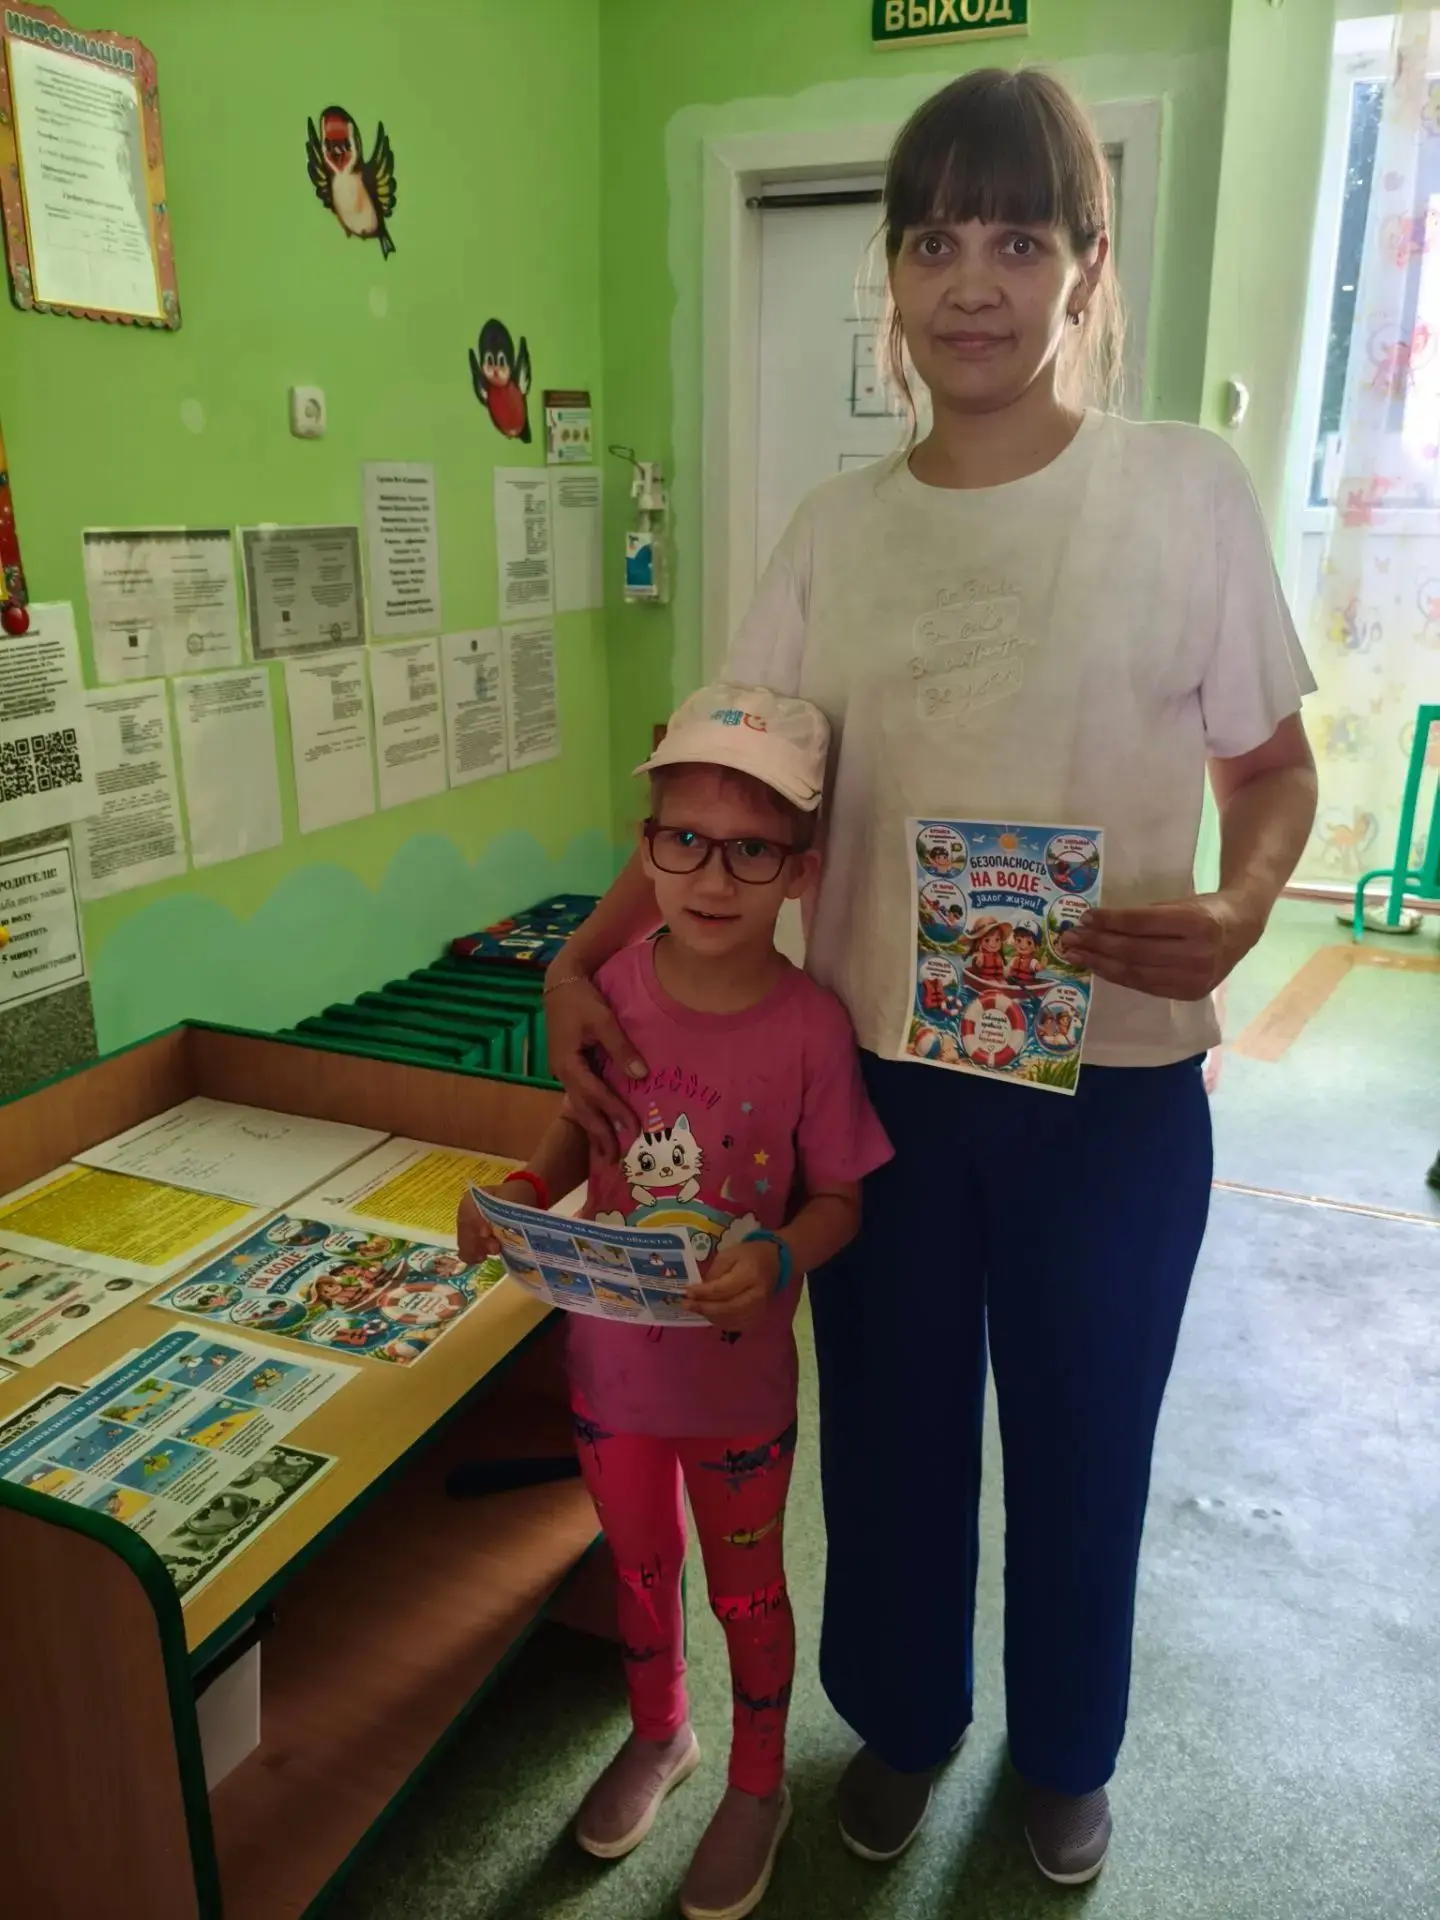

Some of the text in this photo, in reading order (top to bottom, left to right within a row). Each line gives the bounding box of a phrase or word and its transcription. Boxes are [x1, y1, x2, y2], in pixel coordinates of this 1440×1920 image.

[885, 0, 1012, 31] ВЫХОД
[5, 9, 135, 72] ИНФОРМАЦИЯ
[970, 856, 1047, 875] БЕЗОПАСНОСТЬ
[970, 871, 992, 887] НА
[997, 871, 1040, 892] ВОДЕ
[976, 894, 1041, 909] залог жизни!
[248, 1276, 270, 1290] НА
[264, 1252, 306, 1276] ВОДЕ
